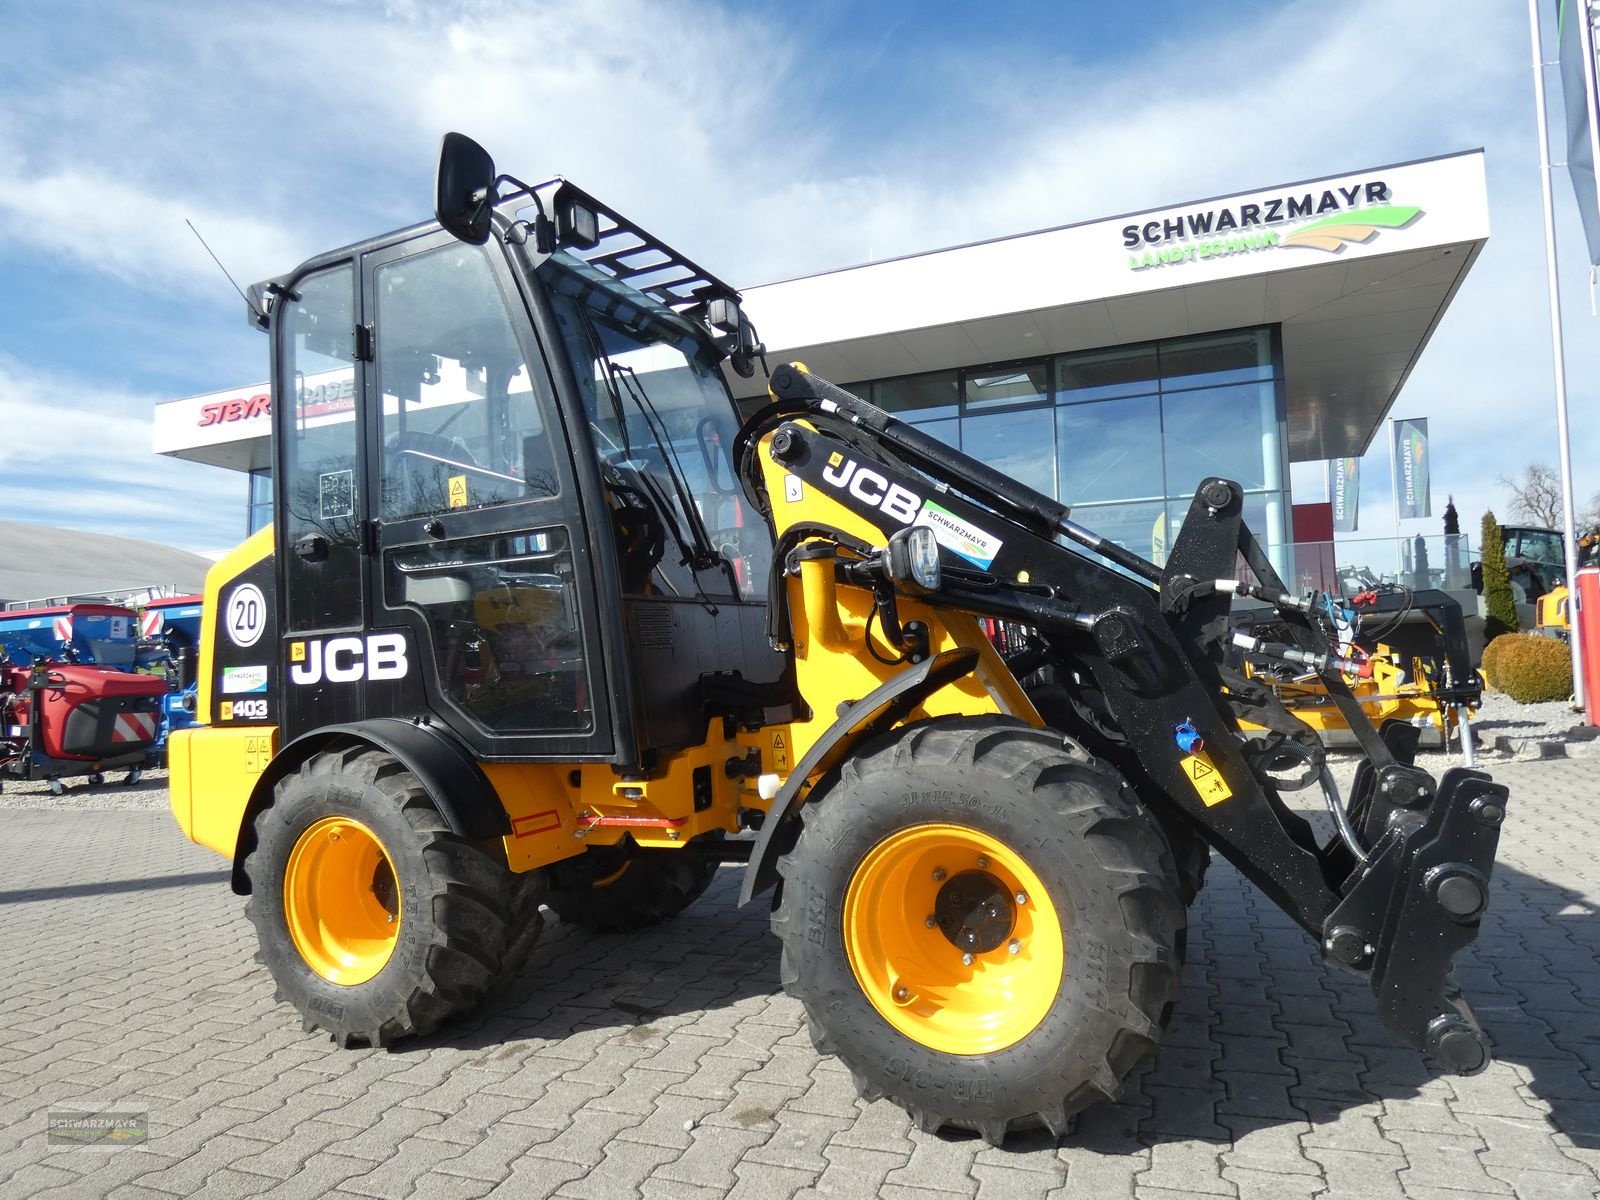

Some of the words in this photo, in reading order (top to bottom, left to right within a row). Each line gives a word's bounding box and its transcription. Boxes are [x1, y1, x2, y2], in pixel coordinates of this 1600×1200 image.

[1122, 181, 1388, 247] SCHWARZMAYR
[1128, 231, 1279, 270] LANDTECHNIK
[197, 394, 272, 427] STEYR
[296, 379, 355, 406] CASE
[822, 459, 922, 525] JCB
[1403, 439, 1415, 506] SCHWARZMAYR
[928, 511, 988, 549] SCHWARZMAYR
[235, 600, 258, 630] 20
[290, 634, 409, 685] JCB
[233, 700, 268, 717] 403
[884, 1057, 993, 1101] TR-315
